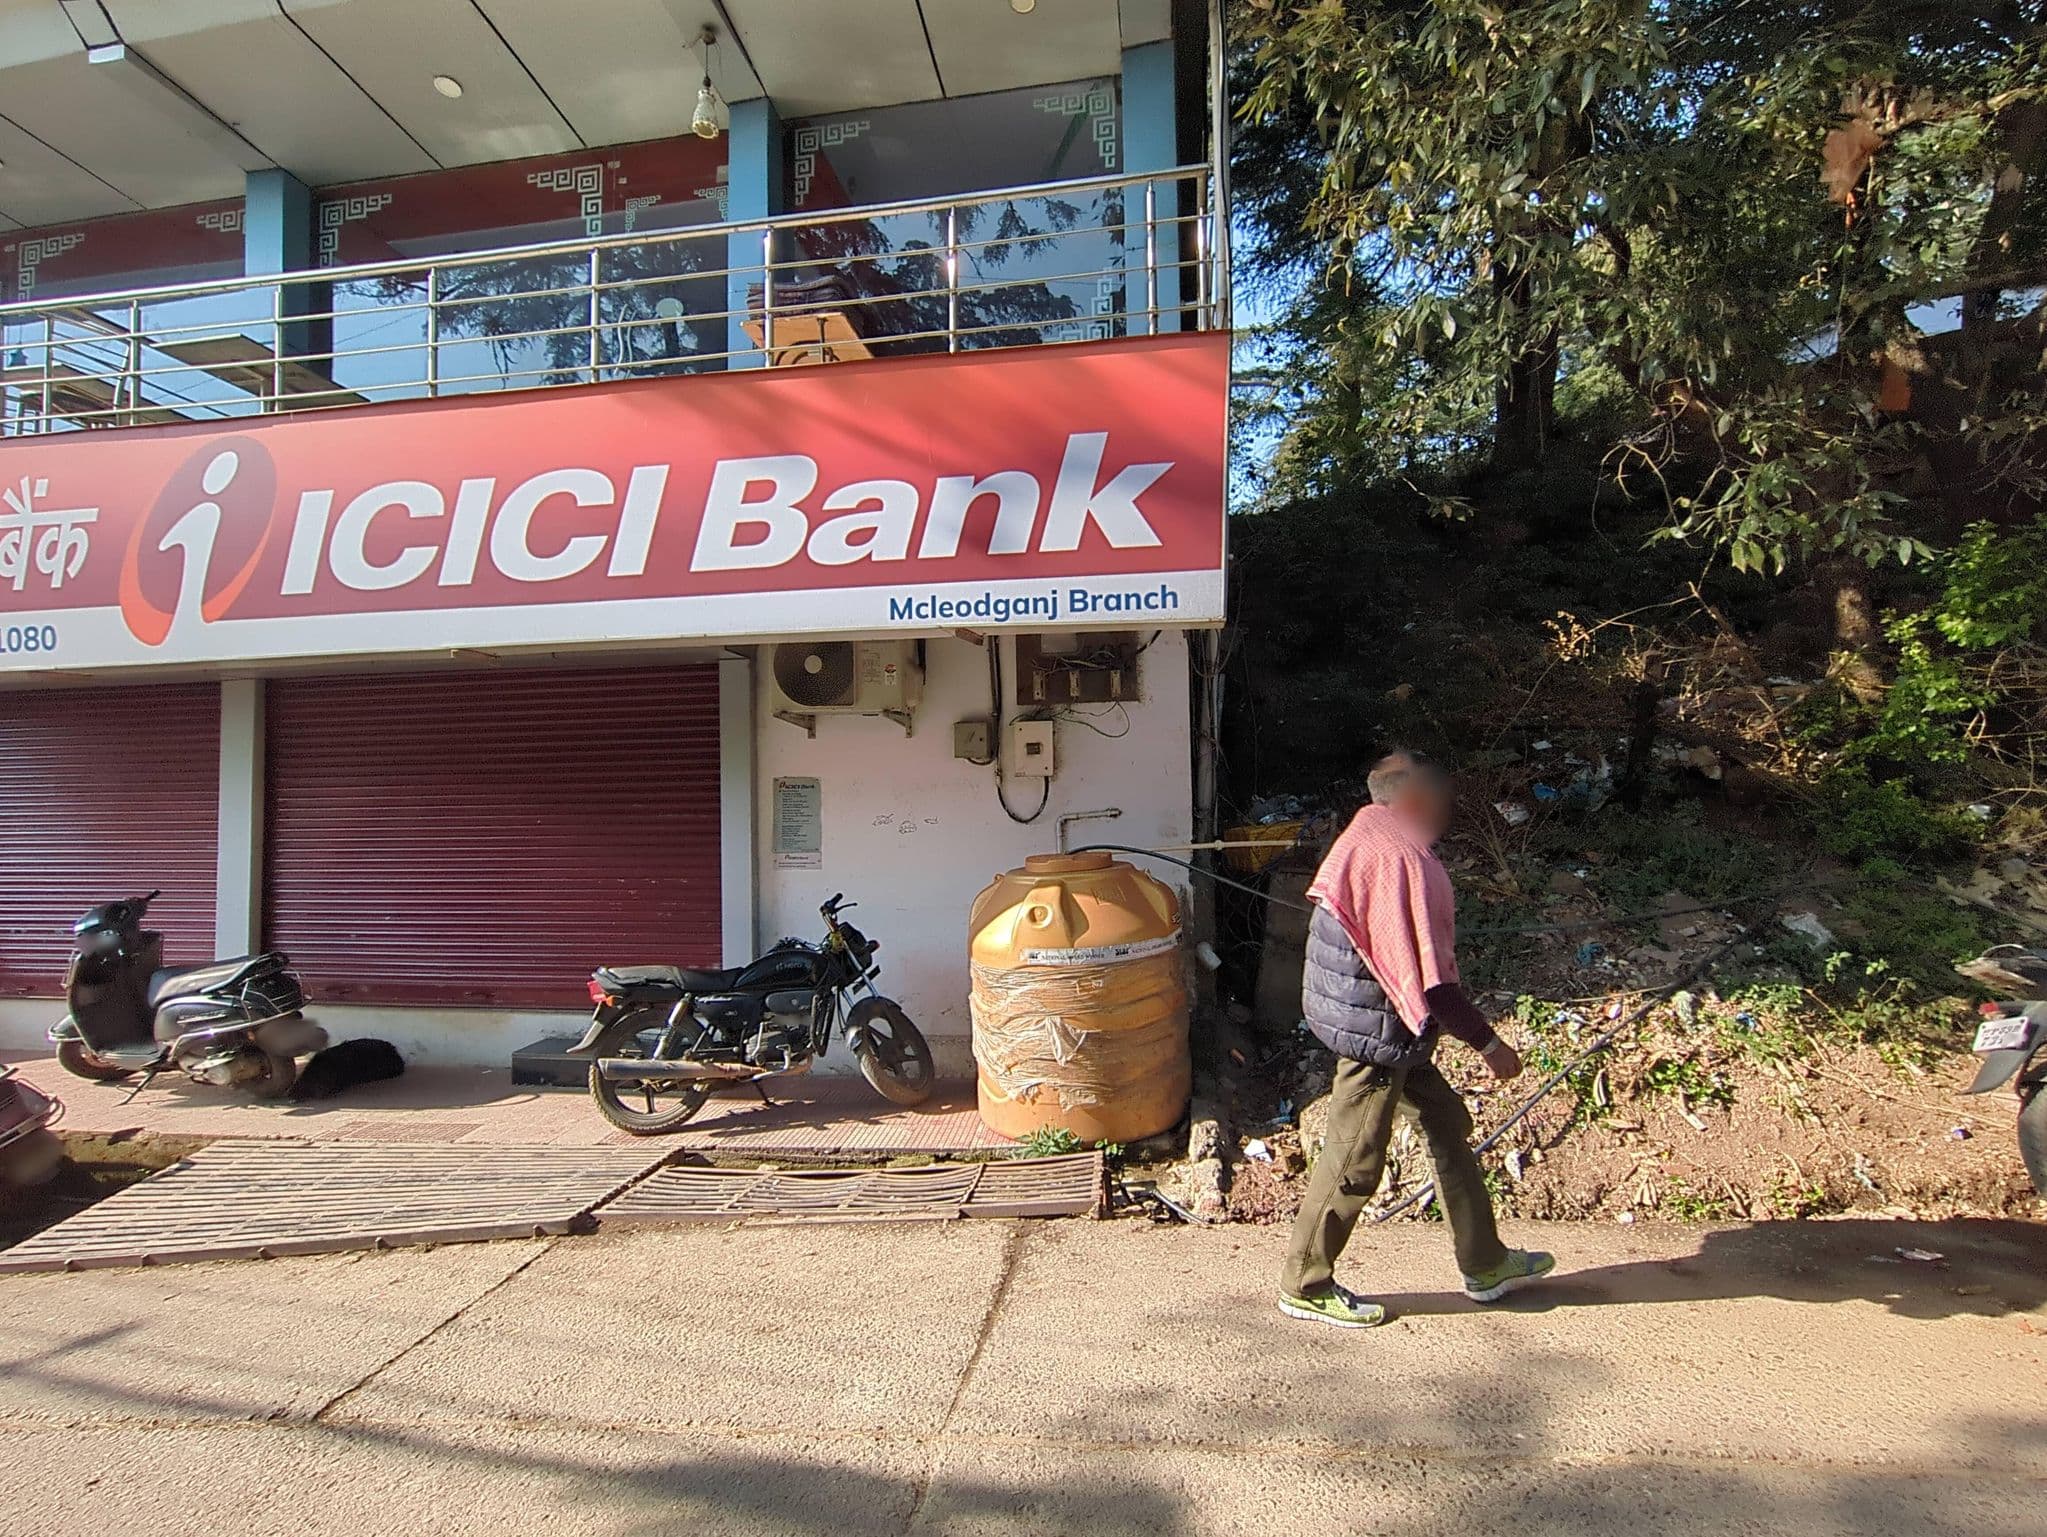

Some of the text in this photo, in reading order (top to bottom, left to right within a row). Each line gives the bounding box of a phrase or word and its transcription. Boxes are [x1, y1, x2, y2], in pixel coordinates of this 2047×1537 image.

[0, 476, 99, 590] बैंक
[280, 464, 670, 595] ICICI
[690, 432, 1175, 573] Bank
[890, 584, 1179, 622] Mcleodganj Branch
